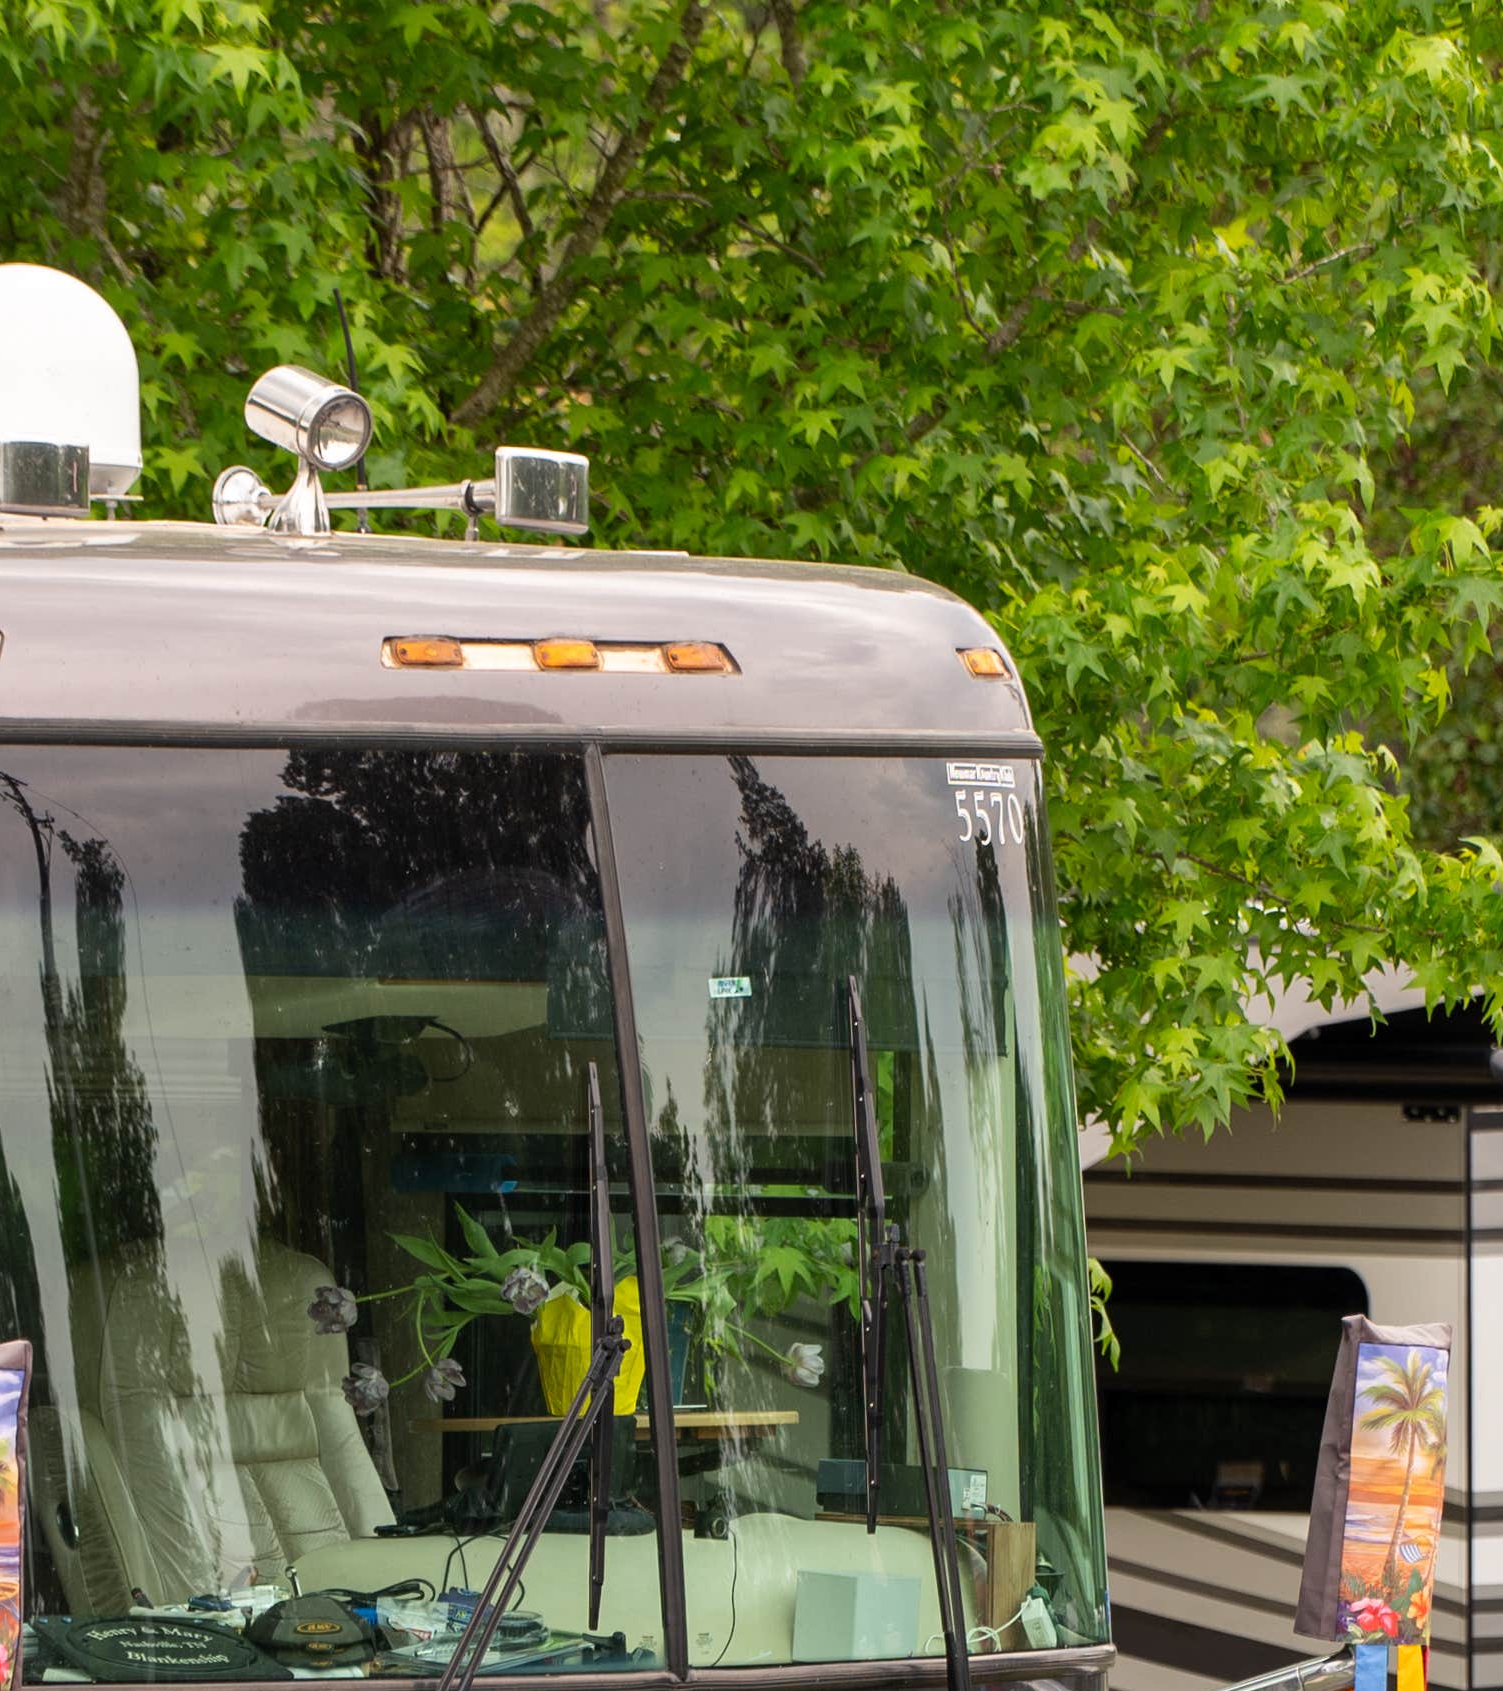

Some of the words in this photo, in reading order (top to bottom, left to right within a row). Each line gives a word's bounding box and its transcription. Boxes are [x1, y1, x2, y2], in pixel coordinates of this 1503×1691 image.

[955, 789, 1024, 846] 5570
[86, 1626, 137, 1641] Henry
[159, 1626, 214, 1642] Mary
